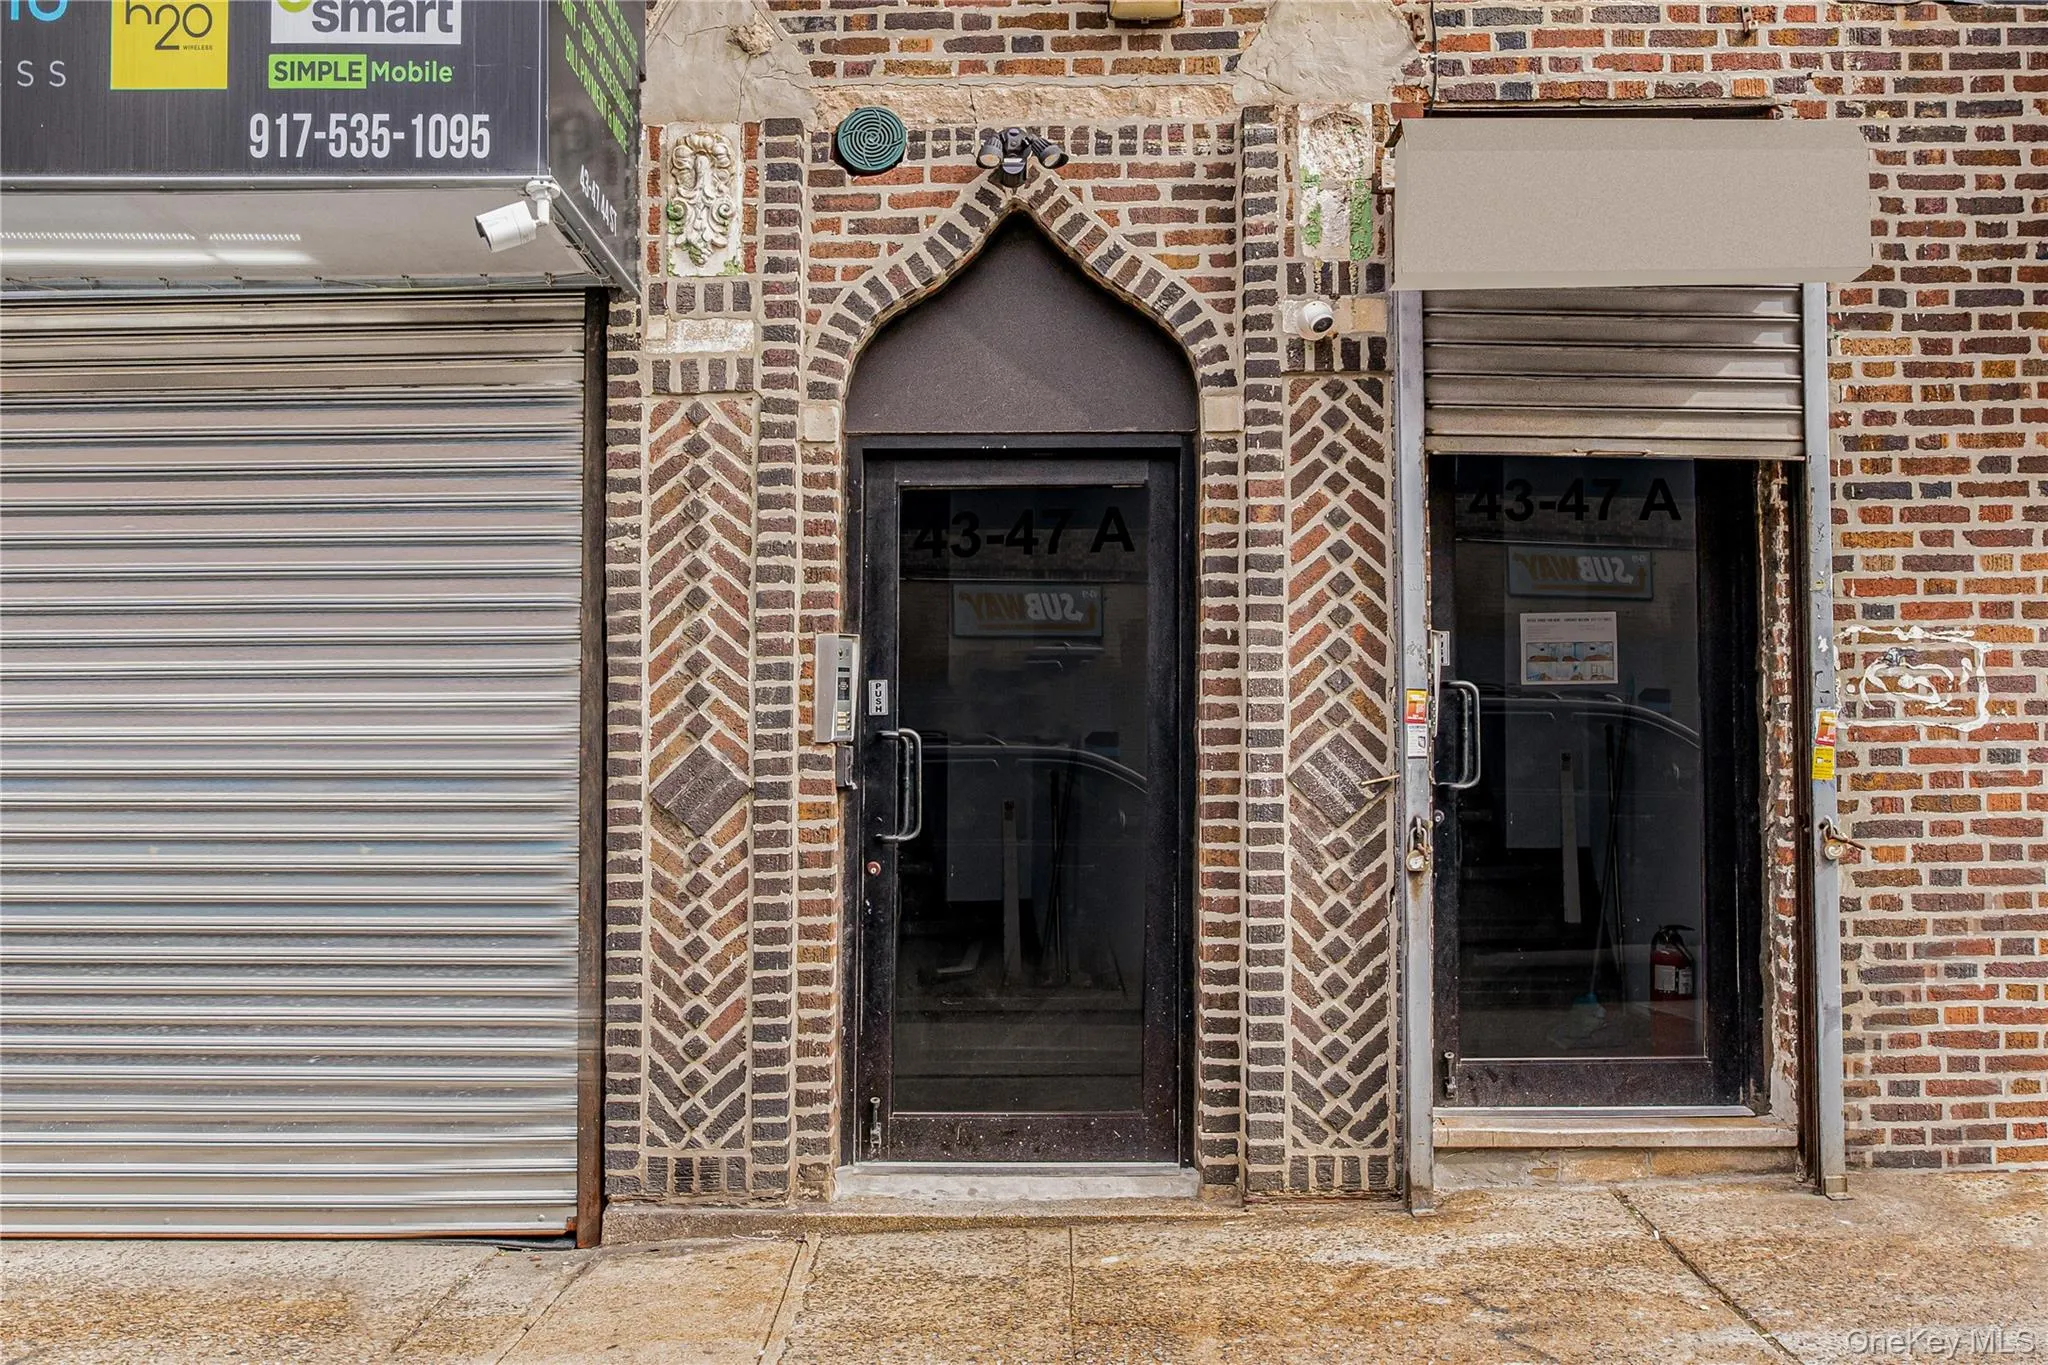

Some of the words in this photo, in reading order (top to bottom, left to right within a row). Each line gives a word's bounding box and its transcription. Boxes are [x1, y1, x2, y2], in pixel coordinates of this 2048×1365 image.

[312, 0, 453, 33] smart
[0, 60, 67, 87] SS
[274, 60, 363, 83] SIMPLE
[371, 60, 454, 83] Mobile
[249, 113, 491, 159] 917-535-1095
[609, 204, 618, 237] ST
[1468, 477, 1623, 523] 43-47
[1638, 477, 1683, 522] A
[912, 507, 1077, 559] 43-47
[1089, 505, 1136, 553] A
